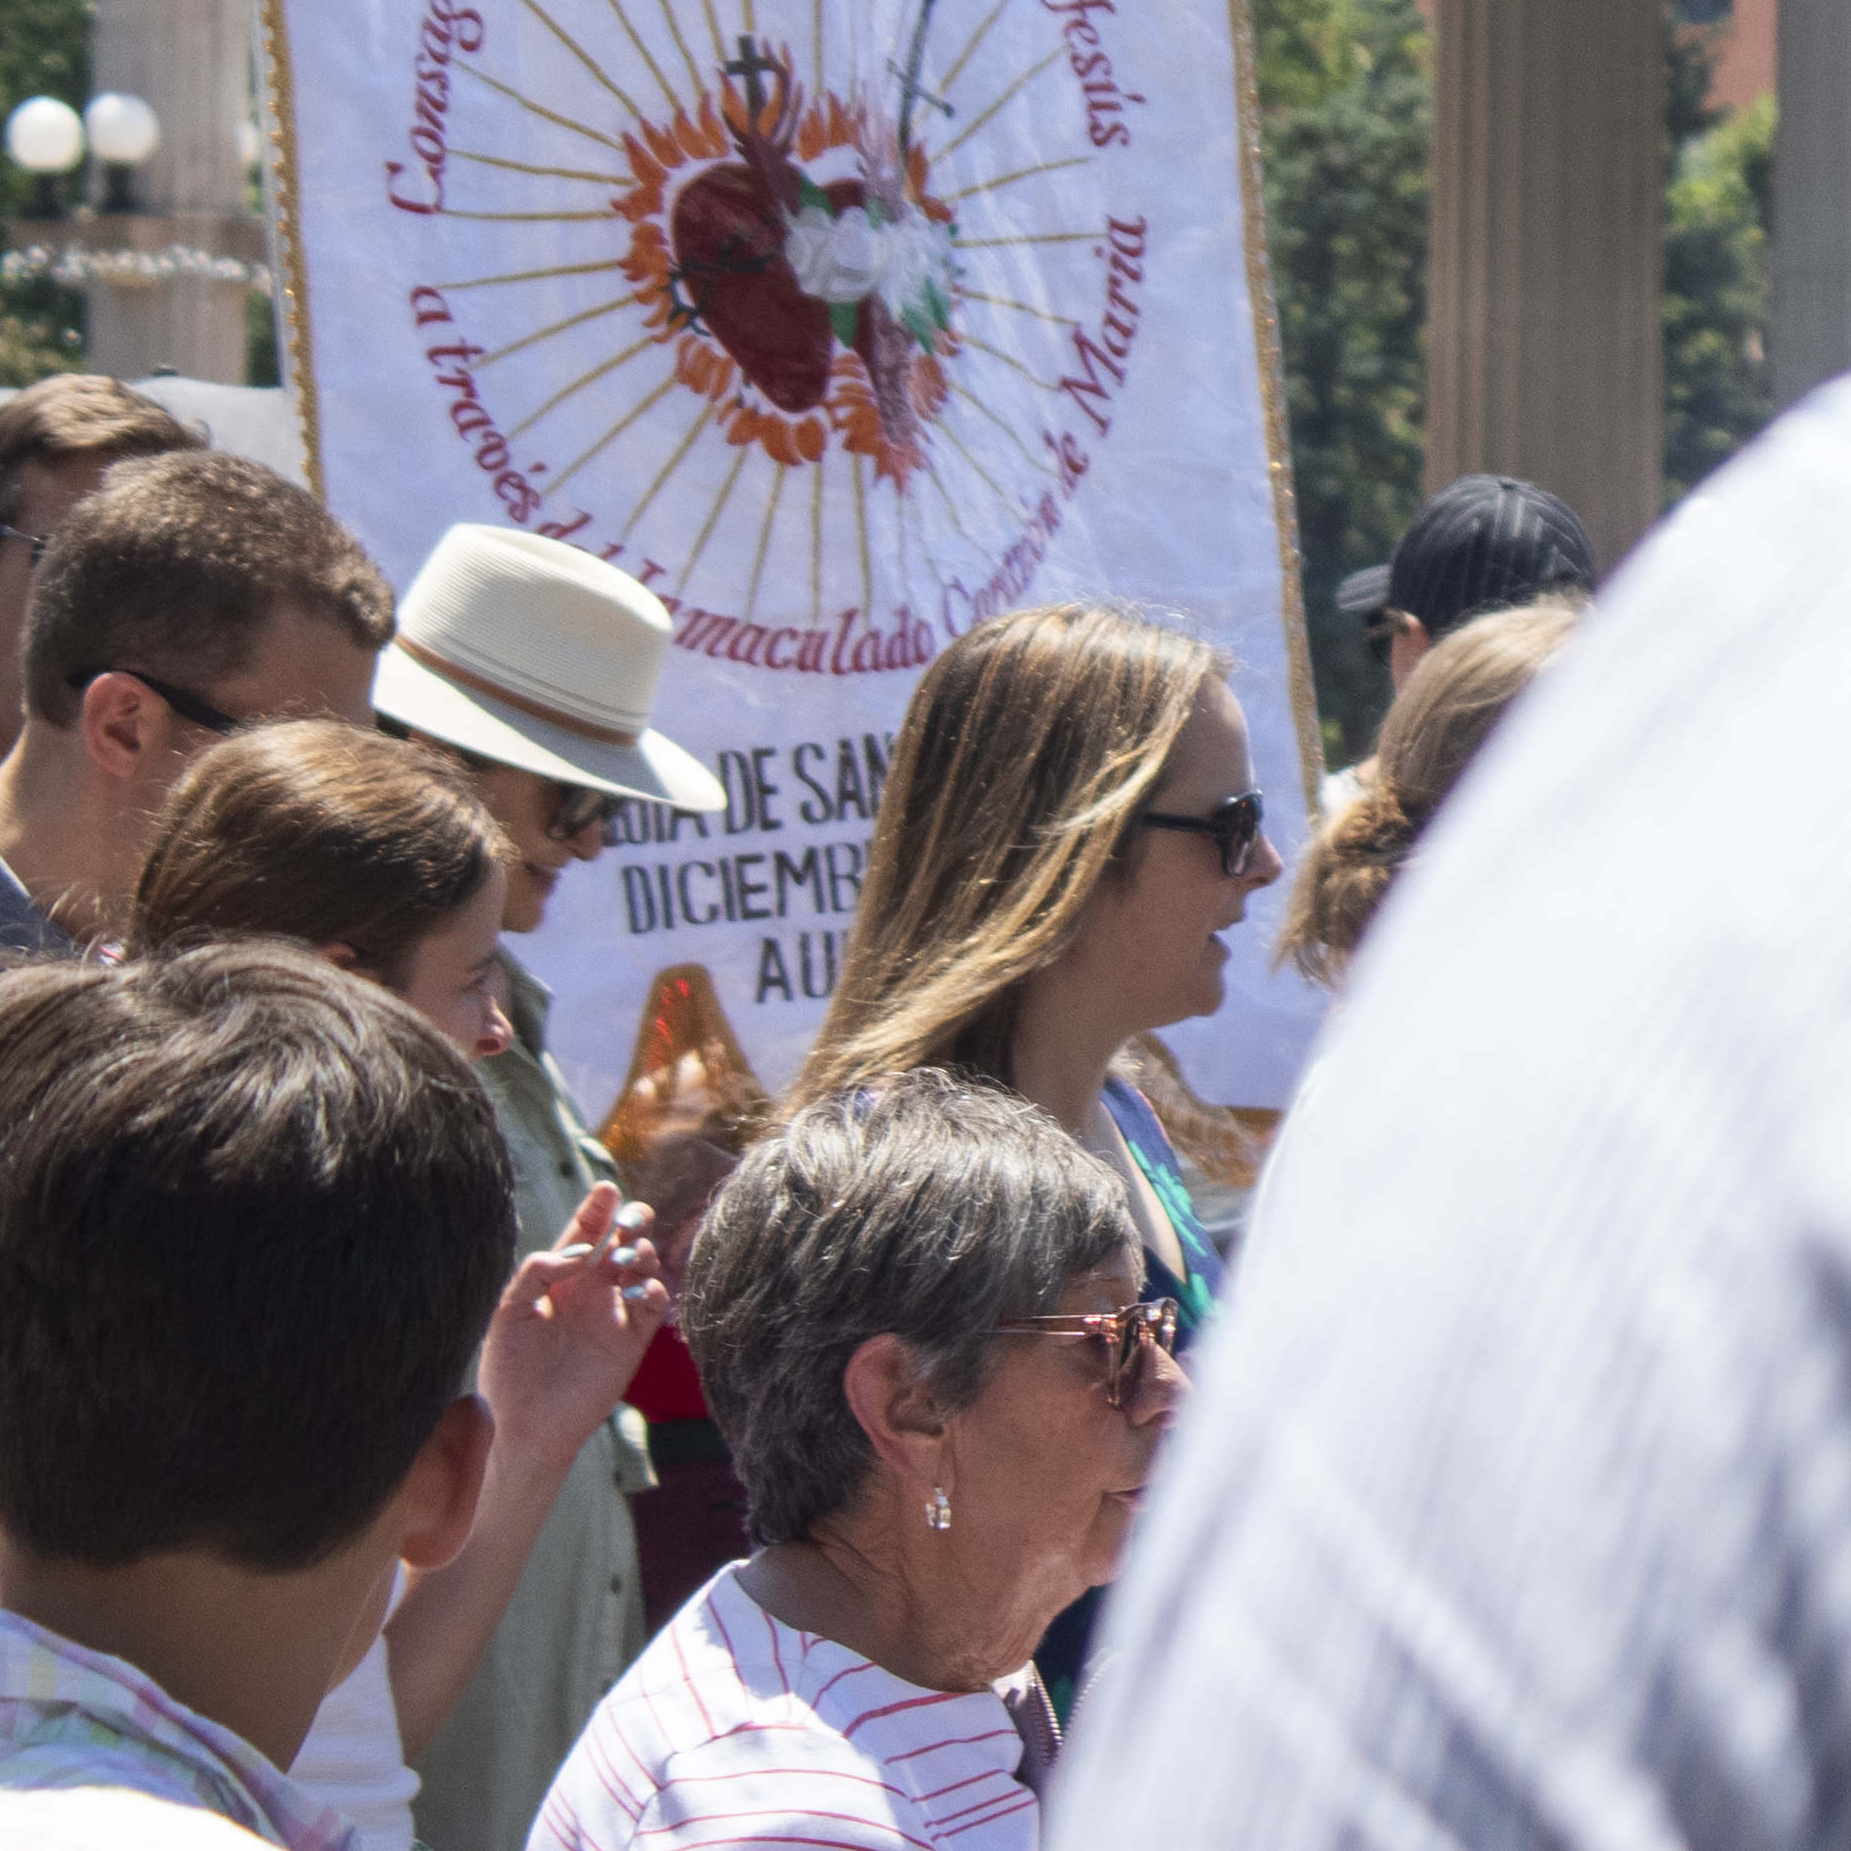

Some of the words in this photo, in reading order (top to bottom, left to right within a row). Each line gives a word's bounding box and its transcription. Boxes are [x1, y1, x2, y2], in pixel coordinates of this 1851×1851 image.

[409, 284, 453, 326] a
[426, 336, 549, 525] través
[639, 556, 936, 676] maculado
[717, 747, 783, 836] DE
[620, 839, 873, 935] DICIEMB
[754, 930, 850, 1005] AU
